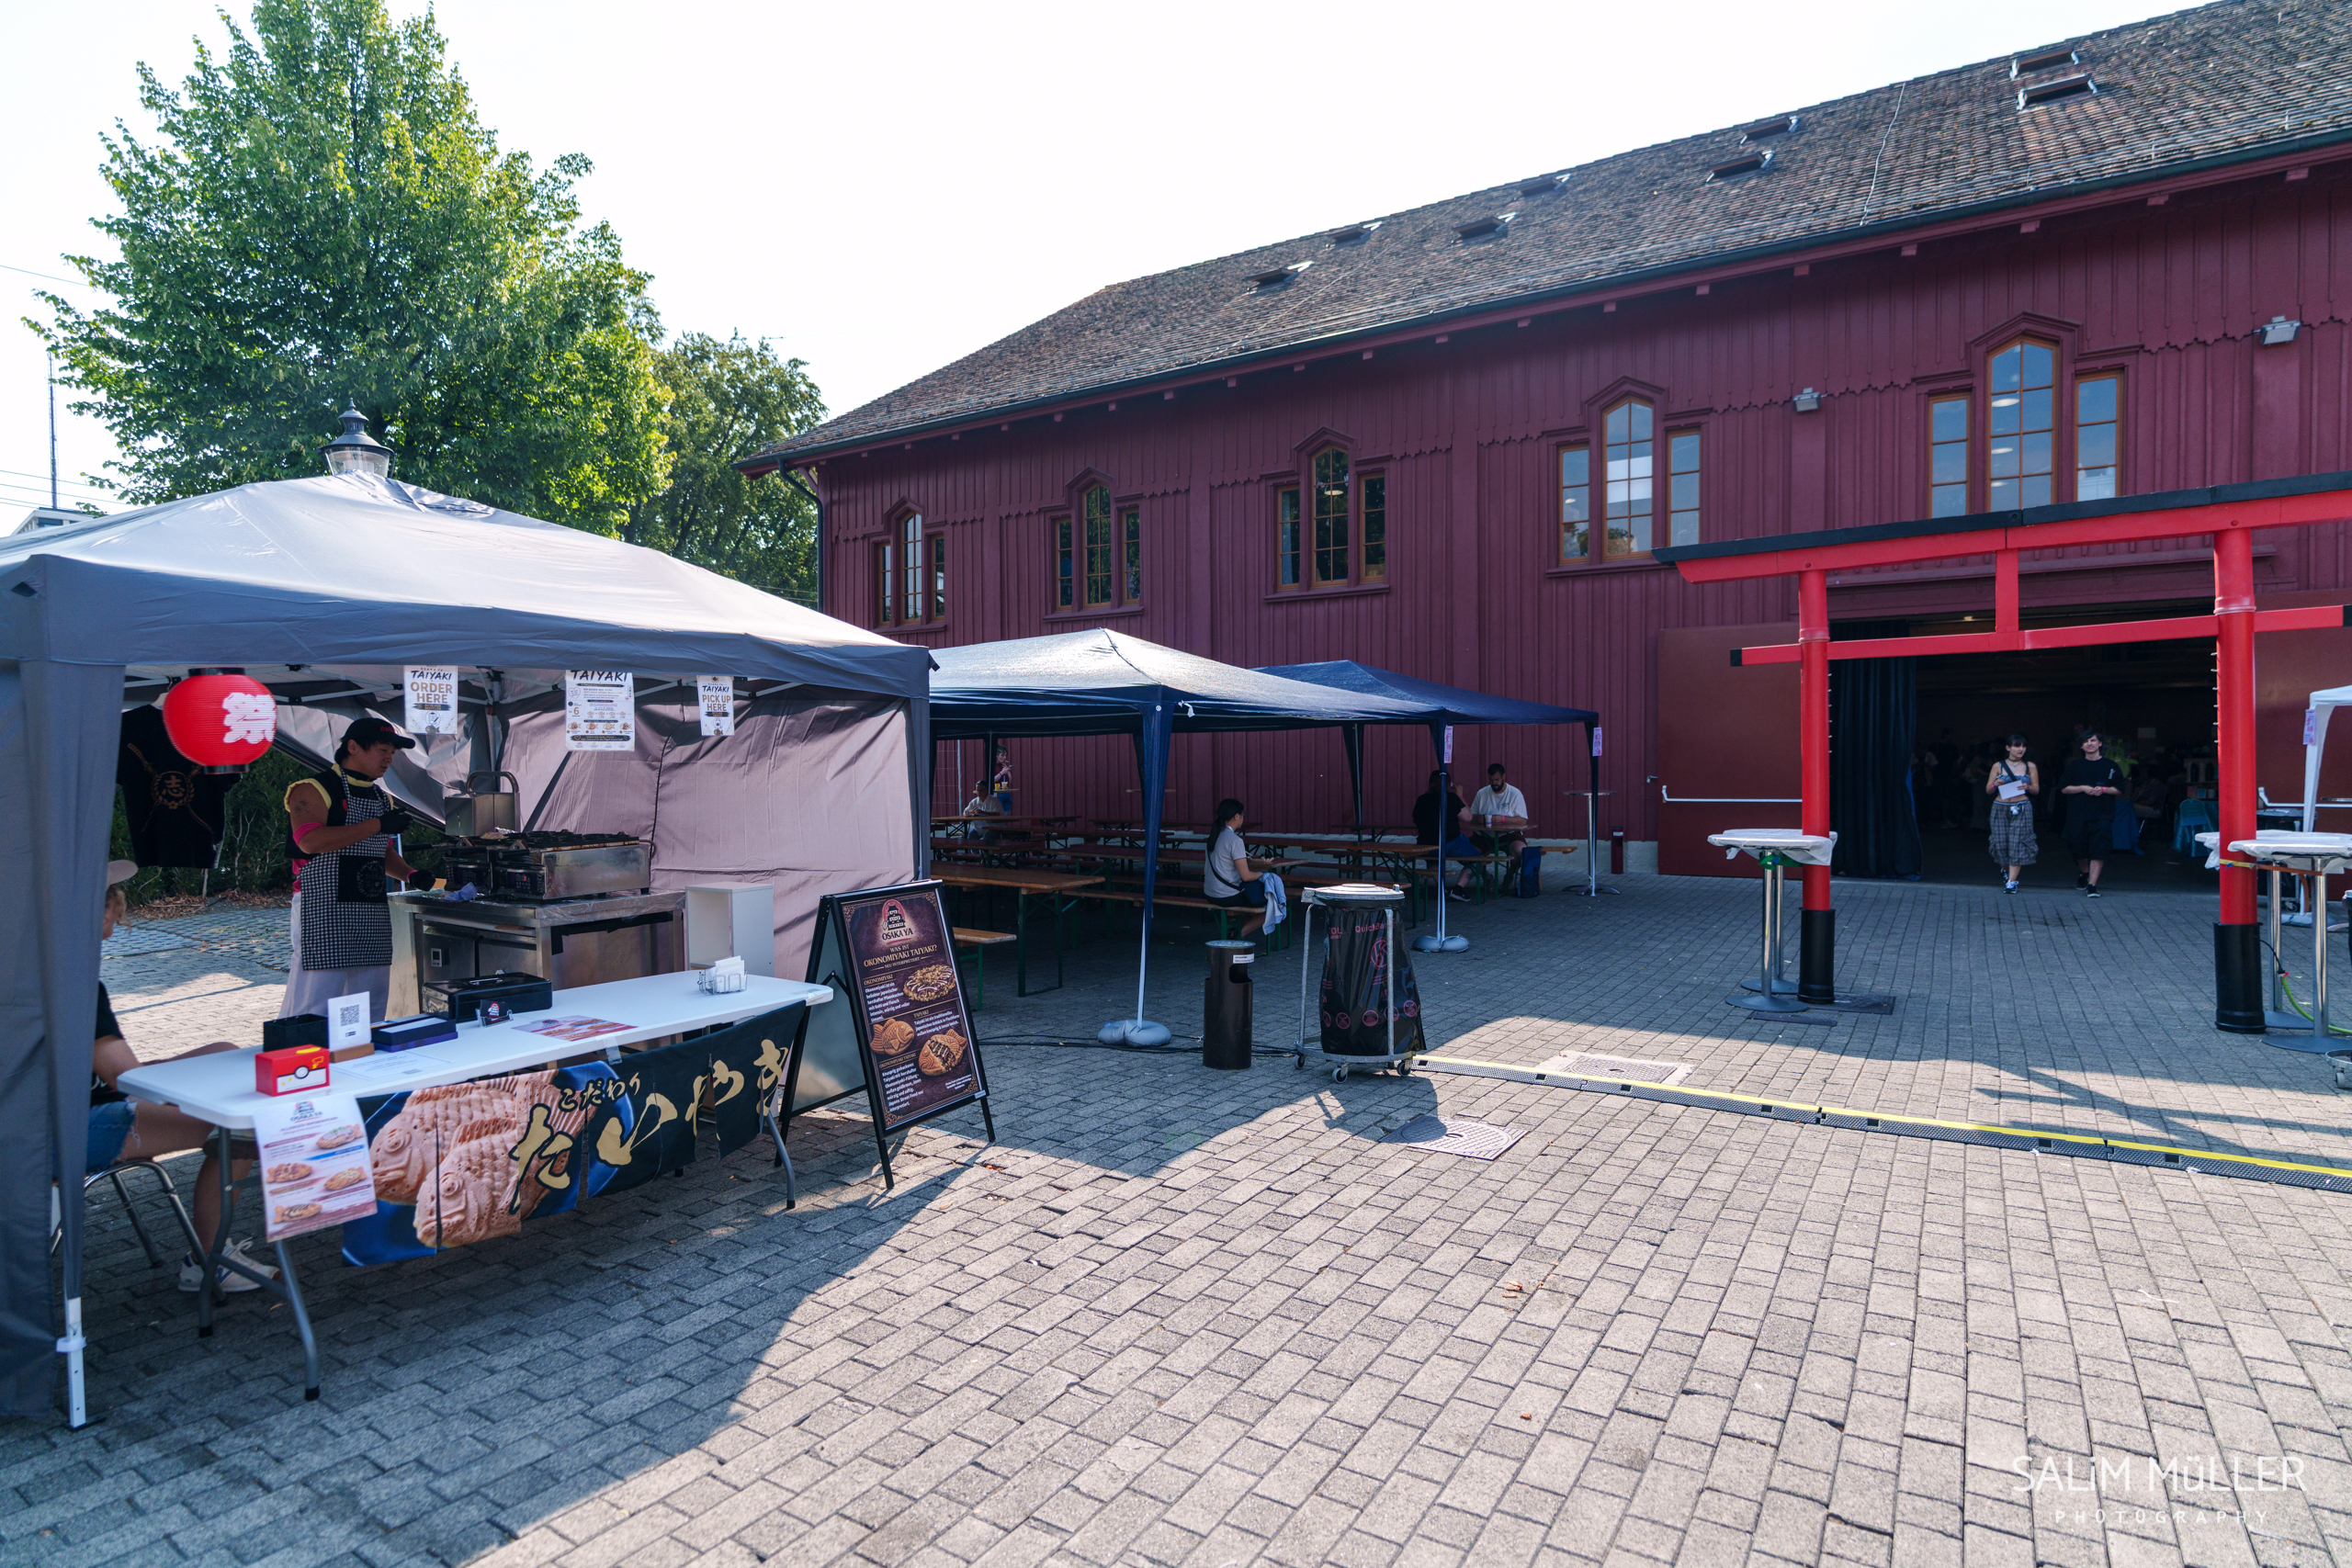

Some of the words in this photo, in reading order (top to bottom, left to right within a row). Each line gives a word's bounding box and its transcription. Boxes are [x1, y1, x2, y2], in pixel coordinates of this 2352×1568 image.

[411, 671, 452, 681] TAIYAKI
[571, 671, 627, 682] TAIYAKI
[411, 682, 452, 694] ORDER
[417, 693, 447, 704] HERE
[702, 694, 720, 703] PICK
[162, 775, 186, 797] 志
[882, 931, 903, 941] OSAKA
[864, 951, 909, 967] OKONOMIYAKI
[910, 944, 937, 956] TAIYAKI?
[559, 1072, 641, 1111] こだわり
[510, 1038, 789, 1214] たいやき
